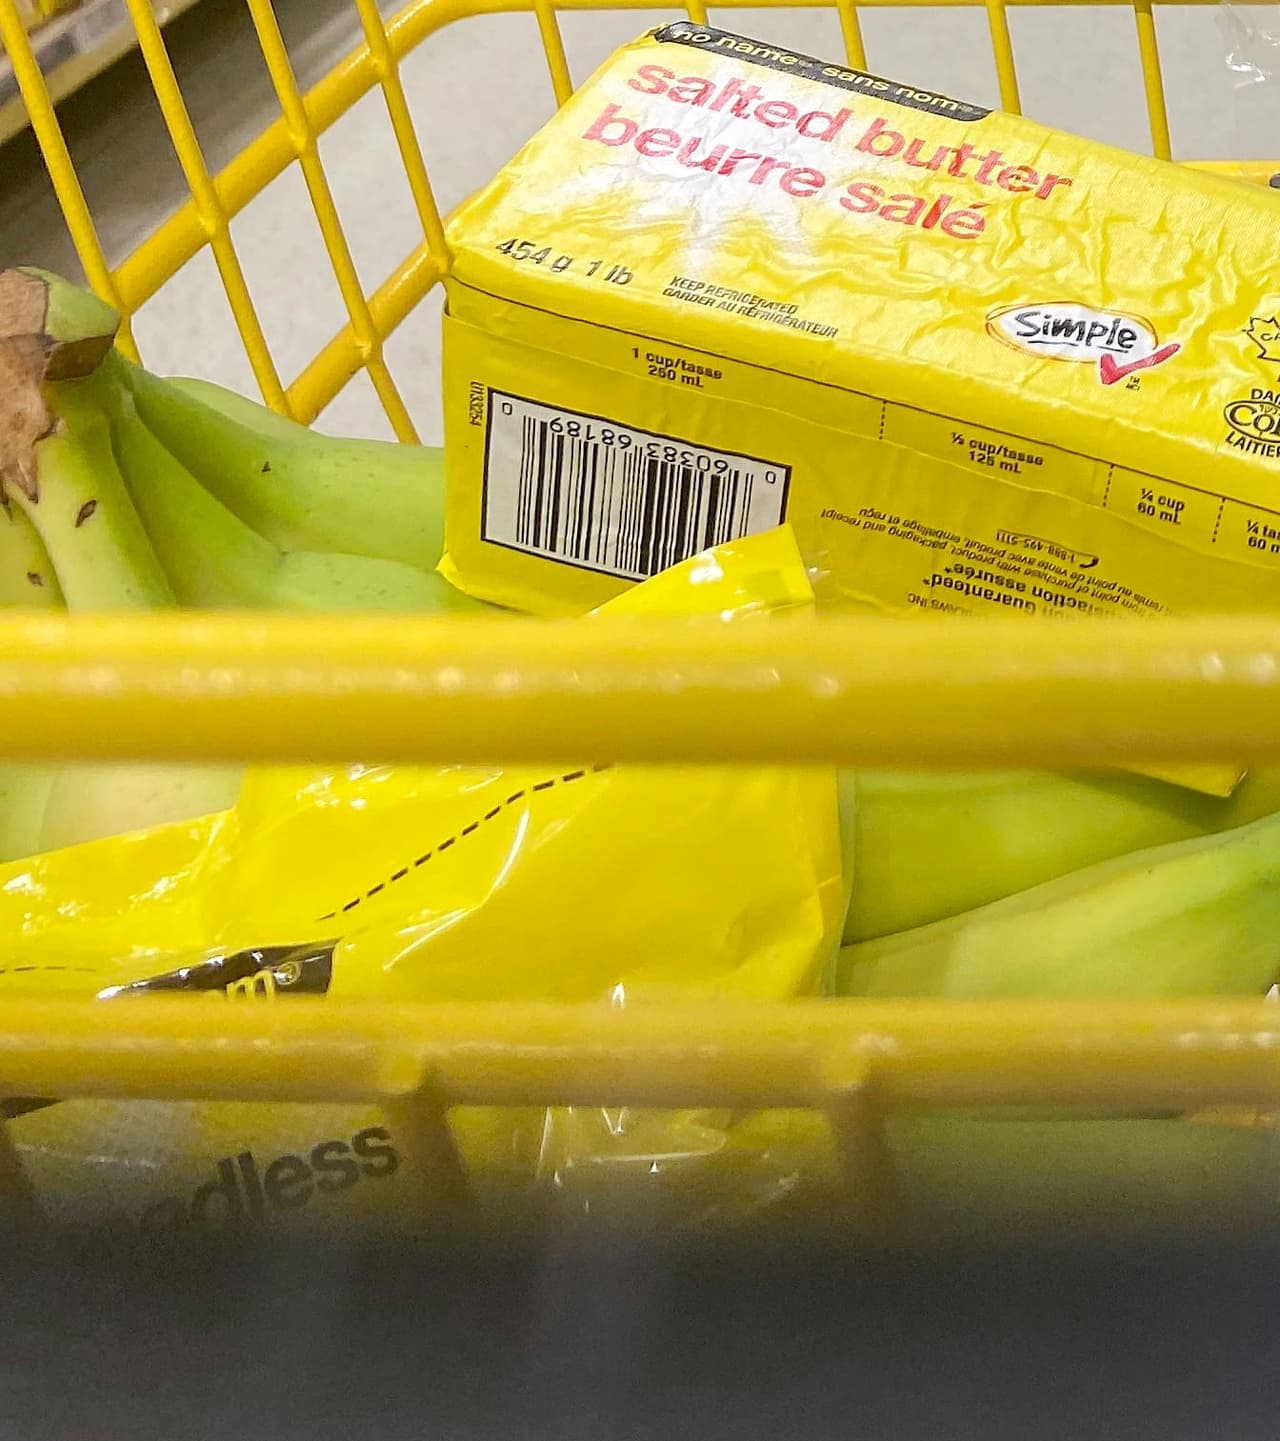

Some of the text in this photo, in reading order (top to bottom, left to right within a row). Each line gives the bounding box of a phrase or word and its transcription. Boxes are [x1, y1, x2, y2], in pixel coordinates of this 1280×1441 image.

[673, 27, 711, 45] no
[821, 65, 890, 92] sans
[626, 62, 1074, 202] salted butter
[583, 103, 988, 242] beurre salé
[495, 238, 634, 286] 454 g 1 lb
[662, 287, 840, 339] GARDER AU RÉFRIGÉRATEUR
[669, 276, 800, 316] KEEP REFRIGERATED
[1013, 310, 1140, 350] Simple
[632, 347, 724, 381] 1 cup/tasse
[648, 364, 706, 389] 250 mL
[548, 415, 633, 451] 68189
[646, 441, 730, 477] 60383
[967, 449, 1024, 476] 125 mL
[969, 436, 1045, 468] cup/tasse
[1136, 502, 1182, 526] 60 mL
[1156, 493, 1186, 513] cup
[1246, 535, 1266, 551] 60
